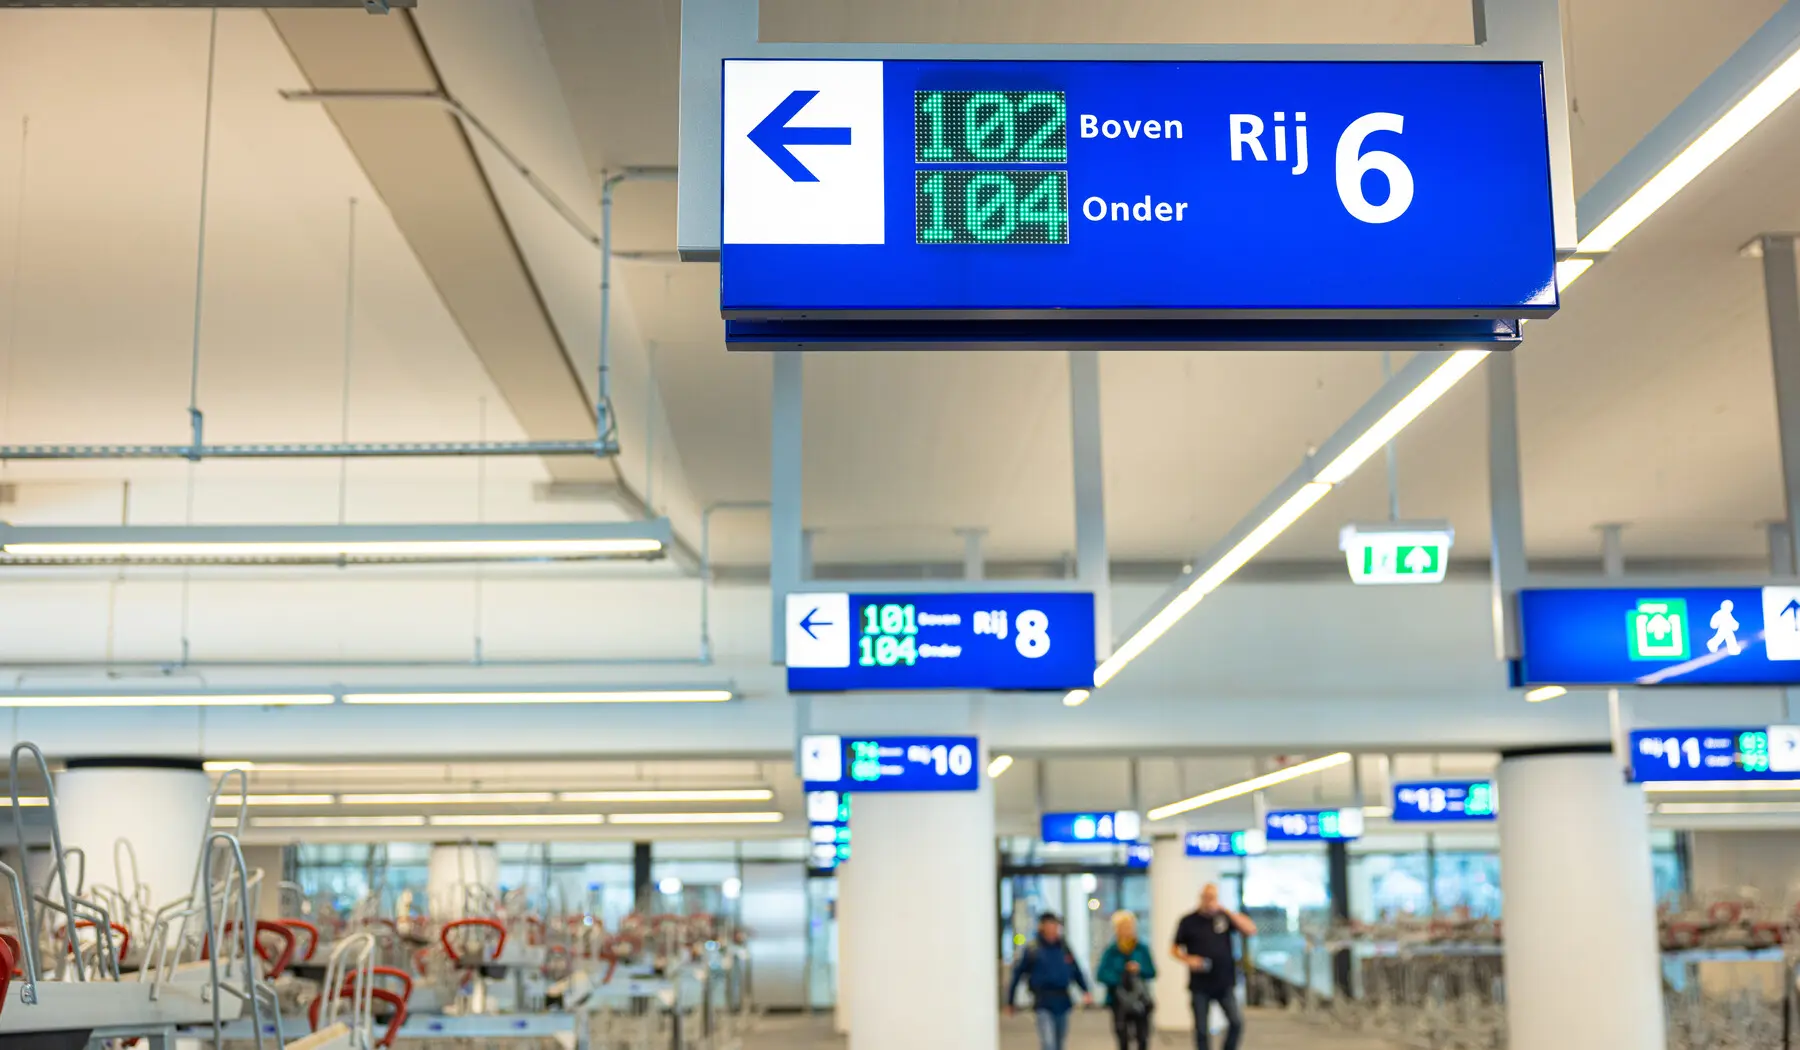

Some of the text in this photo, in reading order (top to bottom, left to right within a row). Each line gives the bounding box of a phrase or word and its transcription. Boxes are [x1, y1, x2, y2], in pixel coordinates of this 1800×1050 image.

[922, 93, 1067, 158] 102
[1079, 114, 1184, 139] Boven
[1229, 111, 1414, 224] Rij 6
[922, 173, 1068, 241] 104
[1082, 195, 1188, 222] Onder
[863, 603, 919, 635] 101
[973, 609, 1051, 659] Rij 8
[859, 634, 919, 667] 104
[931, 744, 972, 776] 10
[1662, 737, 1700, 769] 11
